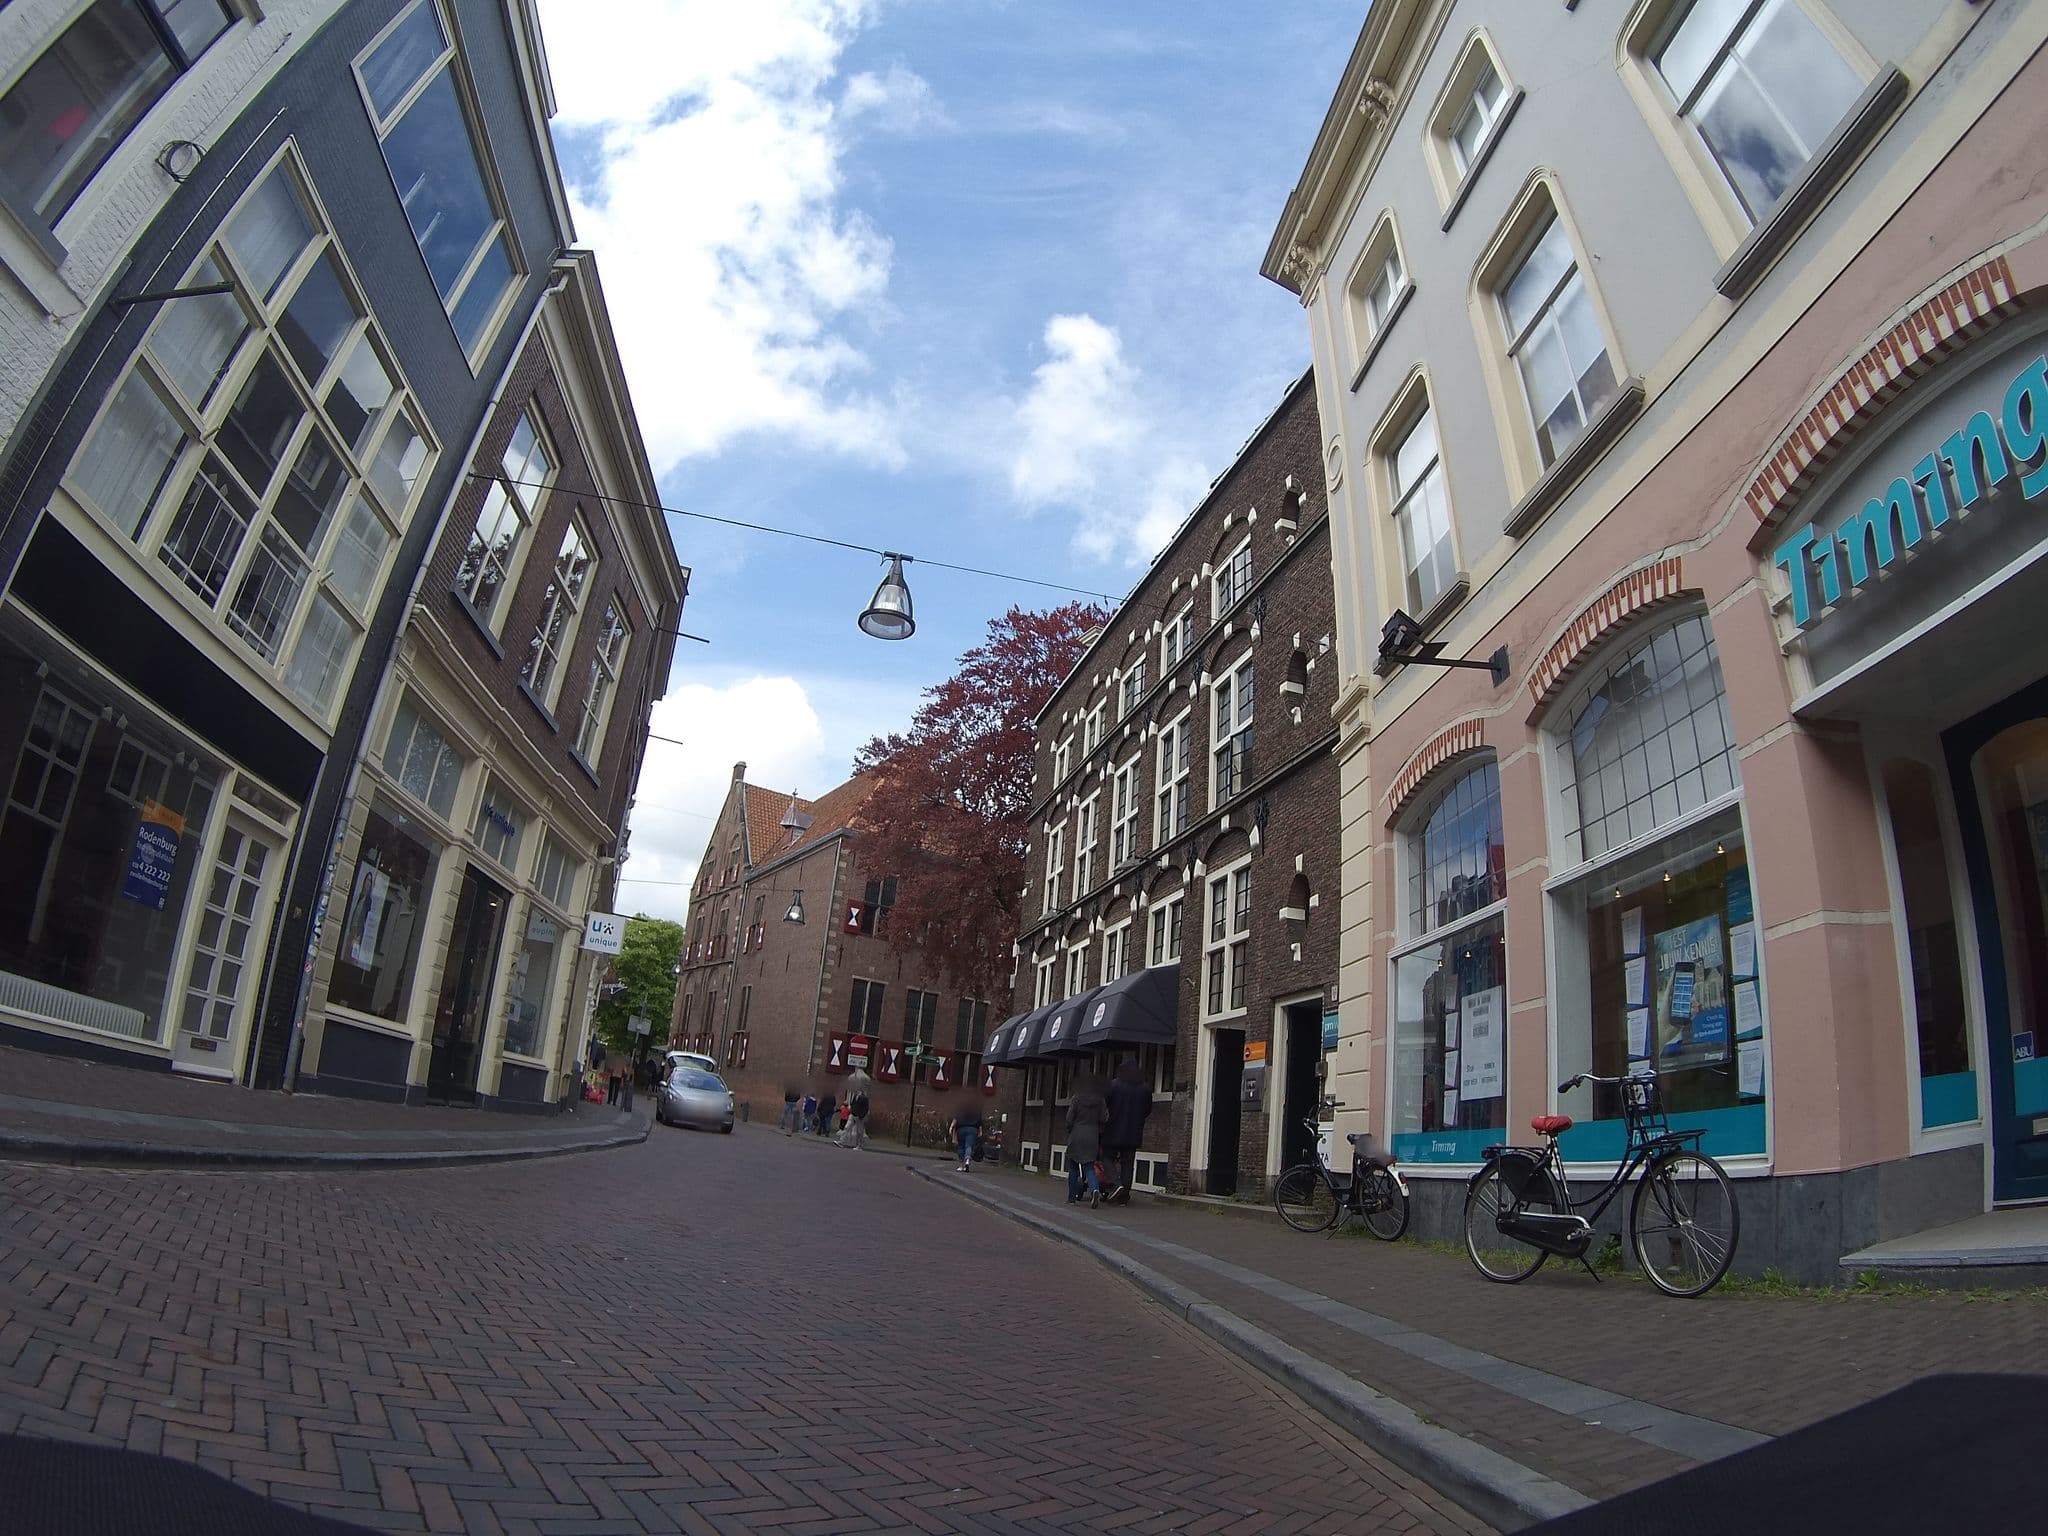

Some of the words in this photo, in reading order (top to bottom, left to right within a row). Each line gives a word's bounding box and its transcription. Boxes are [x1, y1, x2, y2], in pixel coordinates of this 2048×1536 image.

[1773, 353, 2048, 629] Timing
[139, 826, 178, 857] Rodenburg
[589, 937, 618, 948] unique
[1669, 930, 1687, 949] TEST
[1659, 949, 1684, 972] JOUW
[1432, 1140, 1456, 1156] Timing
